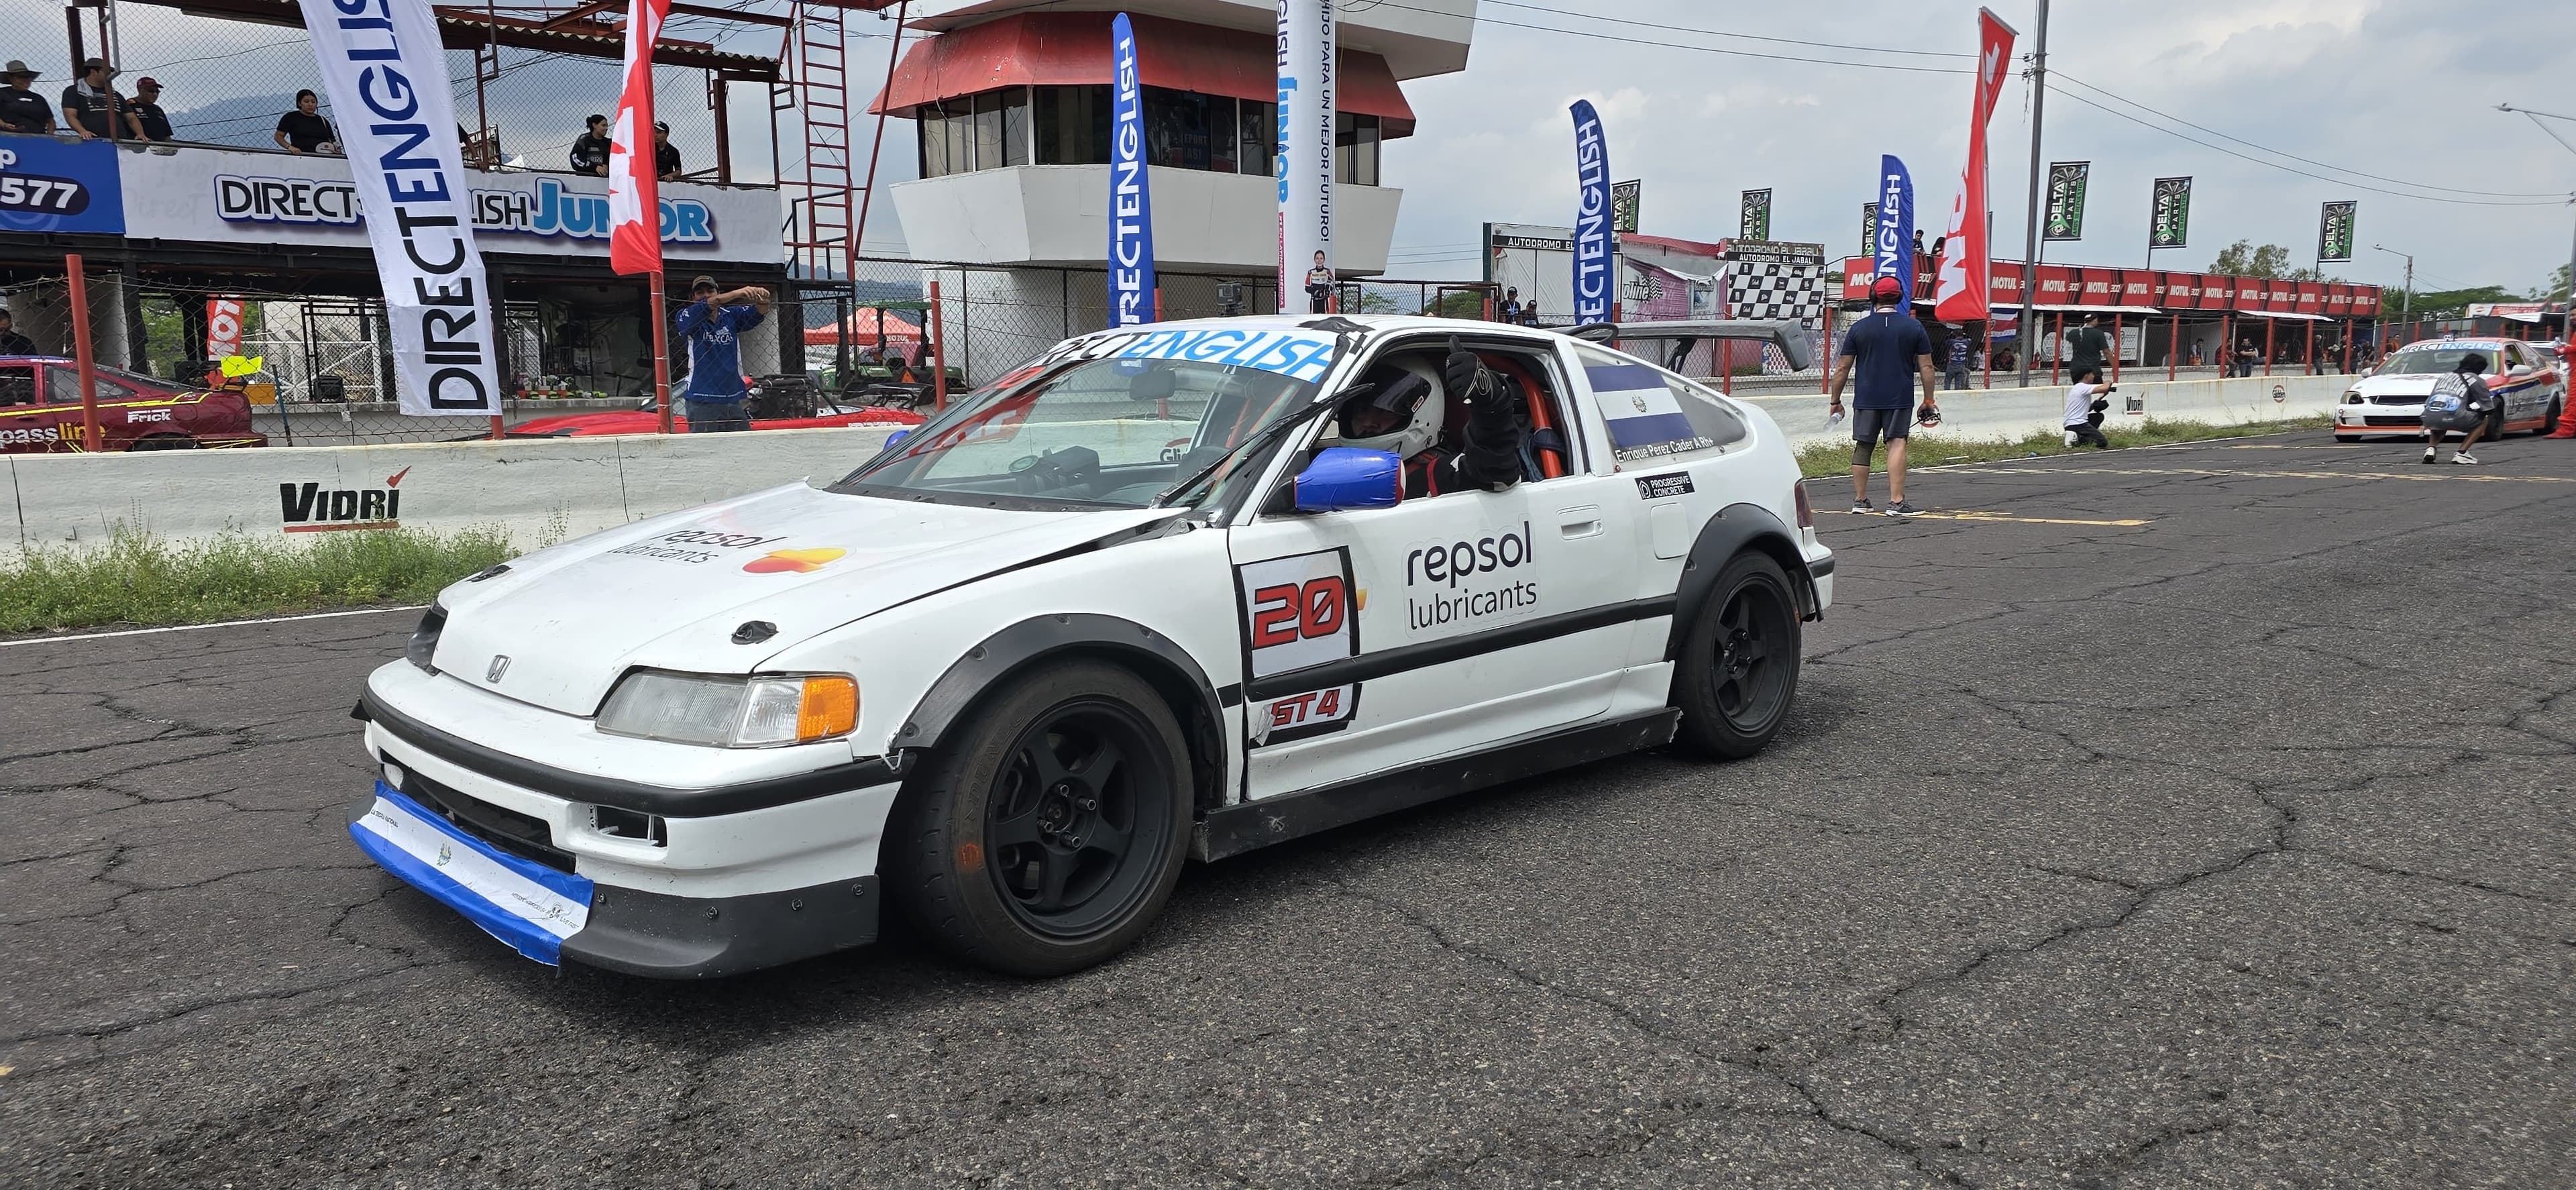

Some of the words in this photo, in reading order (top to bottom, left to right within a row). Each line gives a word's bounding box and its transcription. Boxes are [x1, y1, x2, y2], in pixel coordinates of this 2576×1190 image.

[1320, 40, 1330, 85] PARA
[1320, 89, 1330, 110] UN
[1320, 115, 1330, 170] MEJOR
[221, 180, 356, 218] DIRECT
[1116, 37, 1140, 327] RECTENGLISH
[1320, 174, 1330, 241] FUTURO!
[2051, 182, 2065, 222] DELTA
[2157, 195, 2169, 231] DELTA
[1508, 237, 1561, 249] AUTODROMO
[1878, 174, 1901, 277] NGLISH
[1739, 253, 1780, 262] AUTODROMO
[1991, 276, 2017, 289] MOTUL
[2042, 279, 2065, 292] MOTUL
[2086, 282, 2108, 293] MOTUL
[2127, 283, 2147, 294] MOTUL
[2169, 285, 2189, 296] MOTUL
[127, 409, 171, 423] Frick
[1615, 448, 1649, 462] Enrique
[1647, 444, 1670, 457] Perez
[1669, 439, 1695, 453] Cader
[1694, 437, 1702, 448] A
[1650, 476, 1690, 488] PROGRESSIVE
[1654, 485, 1686, 497] CONCRETE
[606, 543, 719, 563] lubricants
[649, 530, 788, 549] repsol
[1408, 521, 1532, 589] repsol
[1252, 576, 1346, 650] 20
[1409, 580, 1537, 630] lubricants
